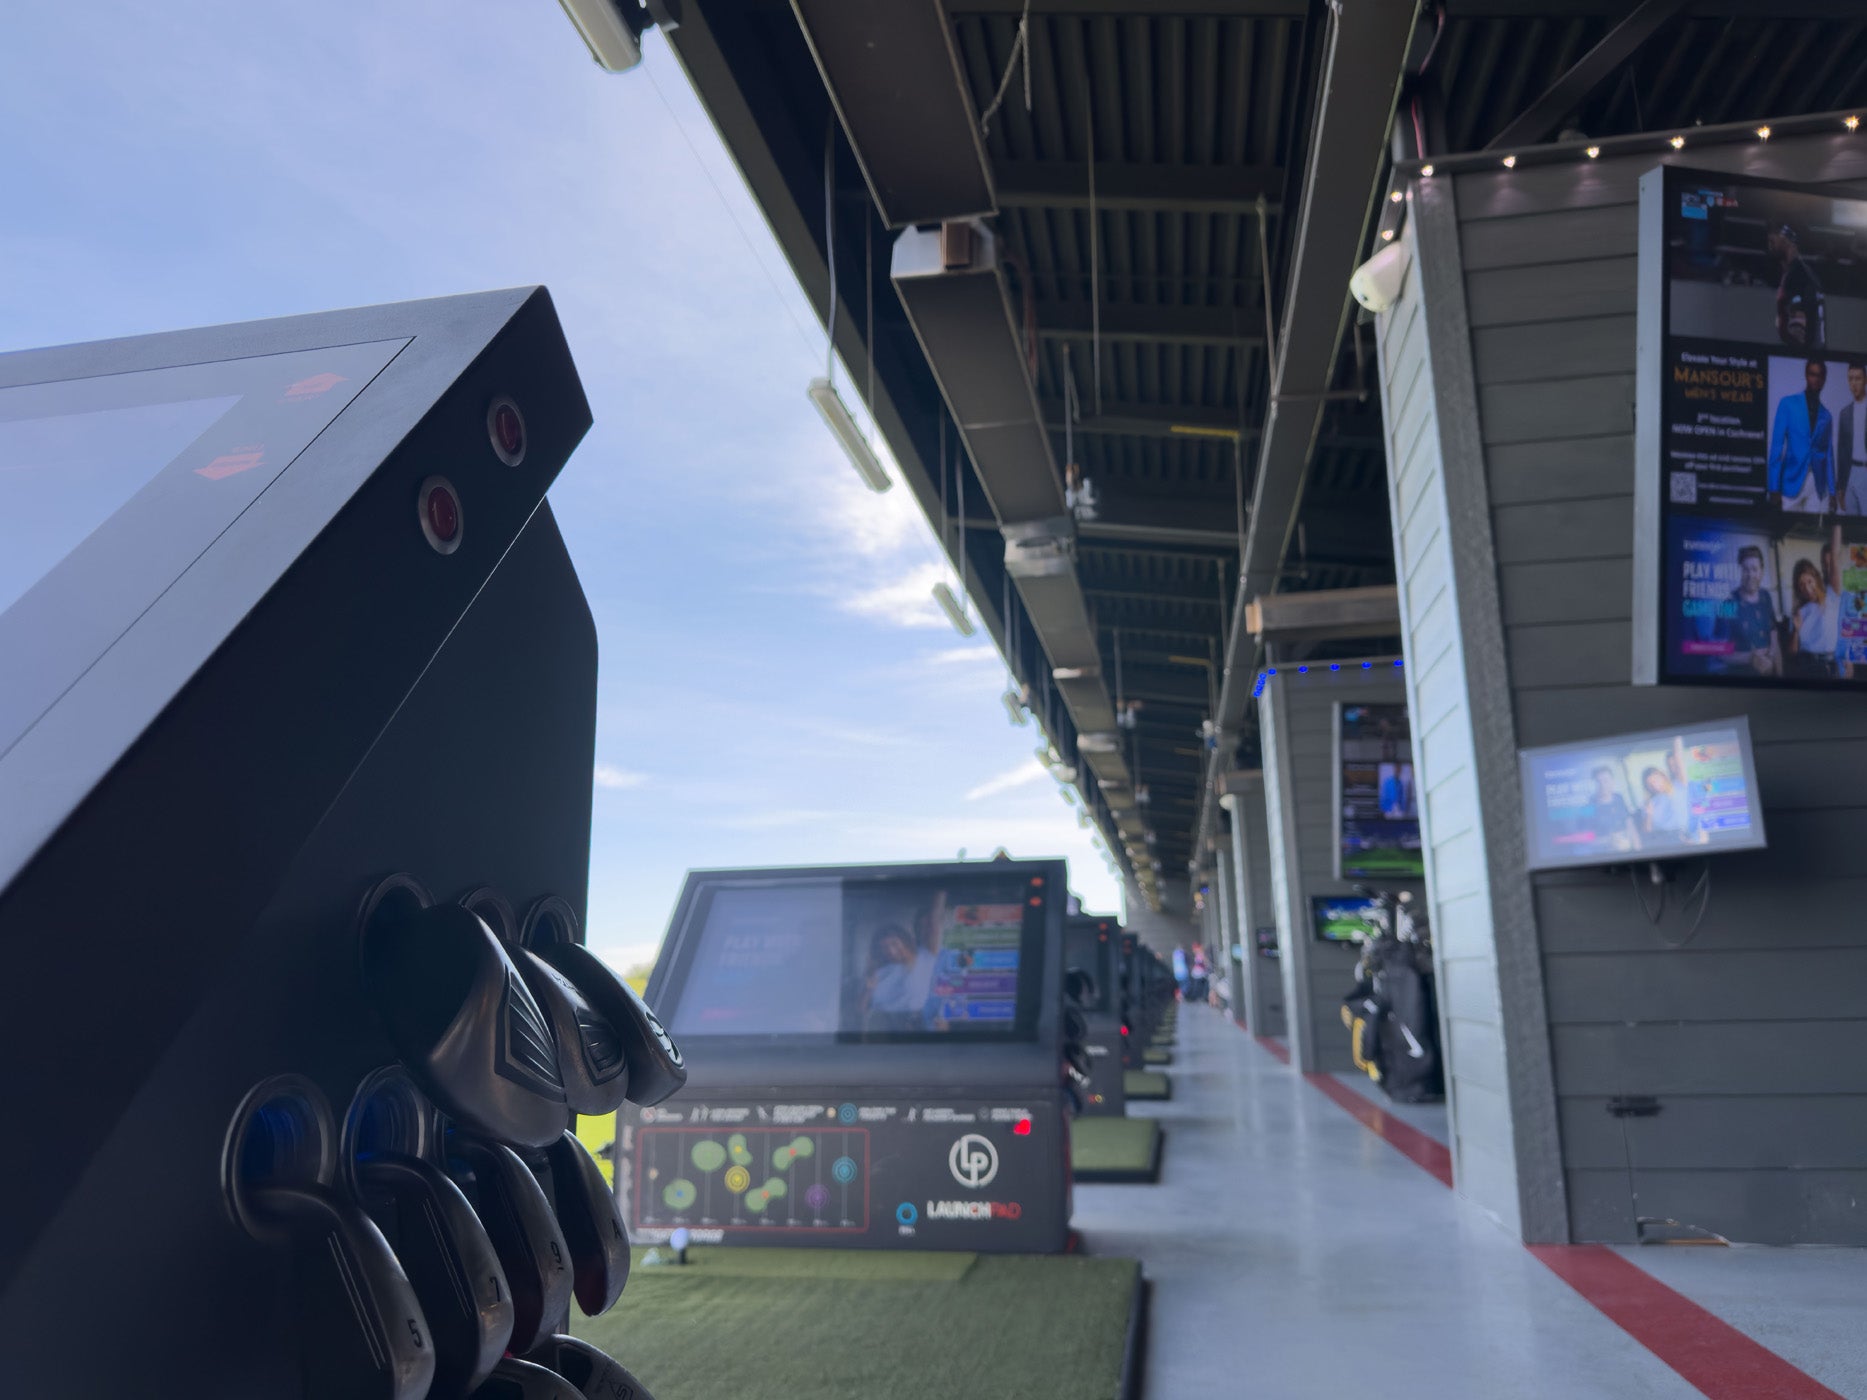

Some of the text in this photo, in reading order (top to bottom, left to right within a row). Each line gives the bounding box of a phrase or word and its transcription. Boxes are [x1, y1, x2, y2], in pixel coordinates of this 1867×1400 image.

[1674, 366, 1764, 389] MANSOUR'S
[1683, 561, 1711, 579] PLAY
[489, 1276, 501, 1303] 7
[407, 1318, 423, 1348] 5
